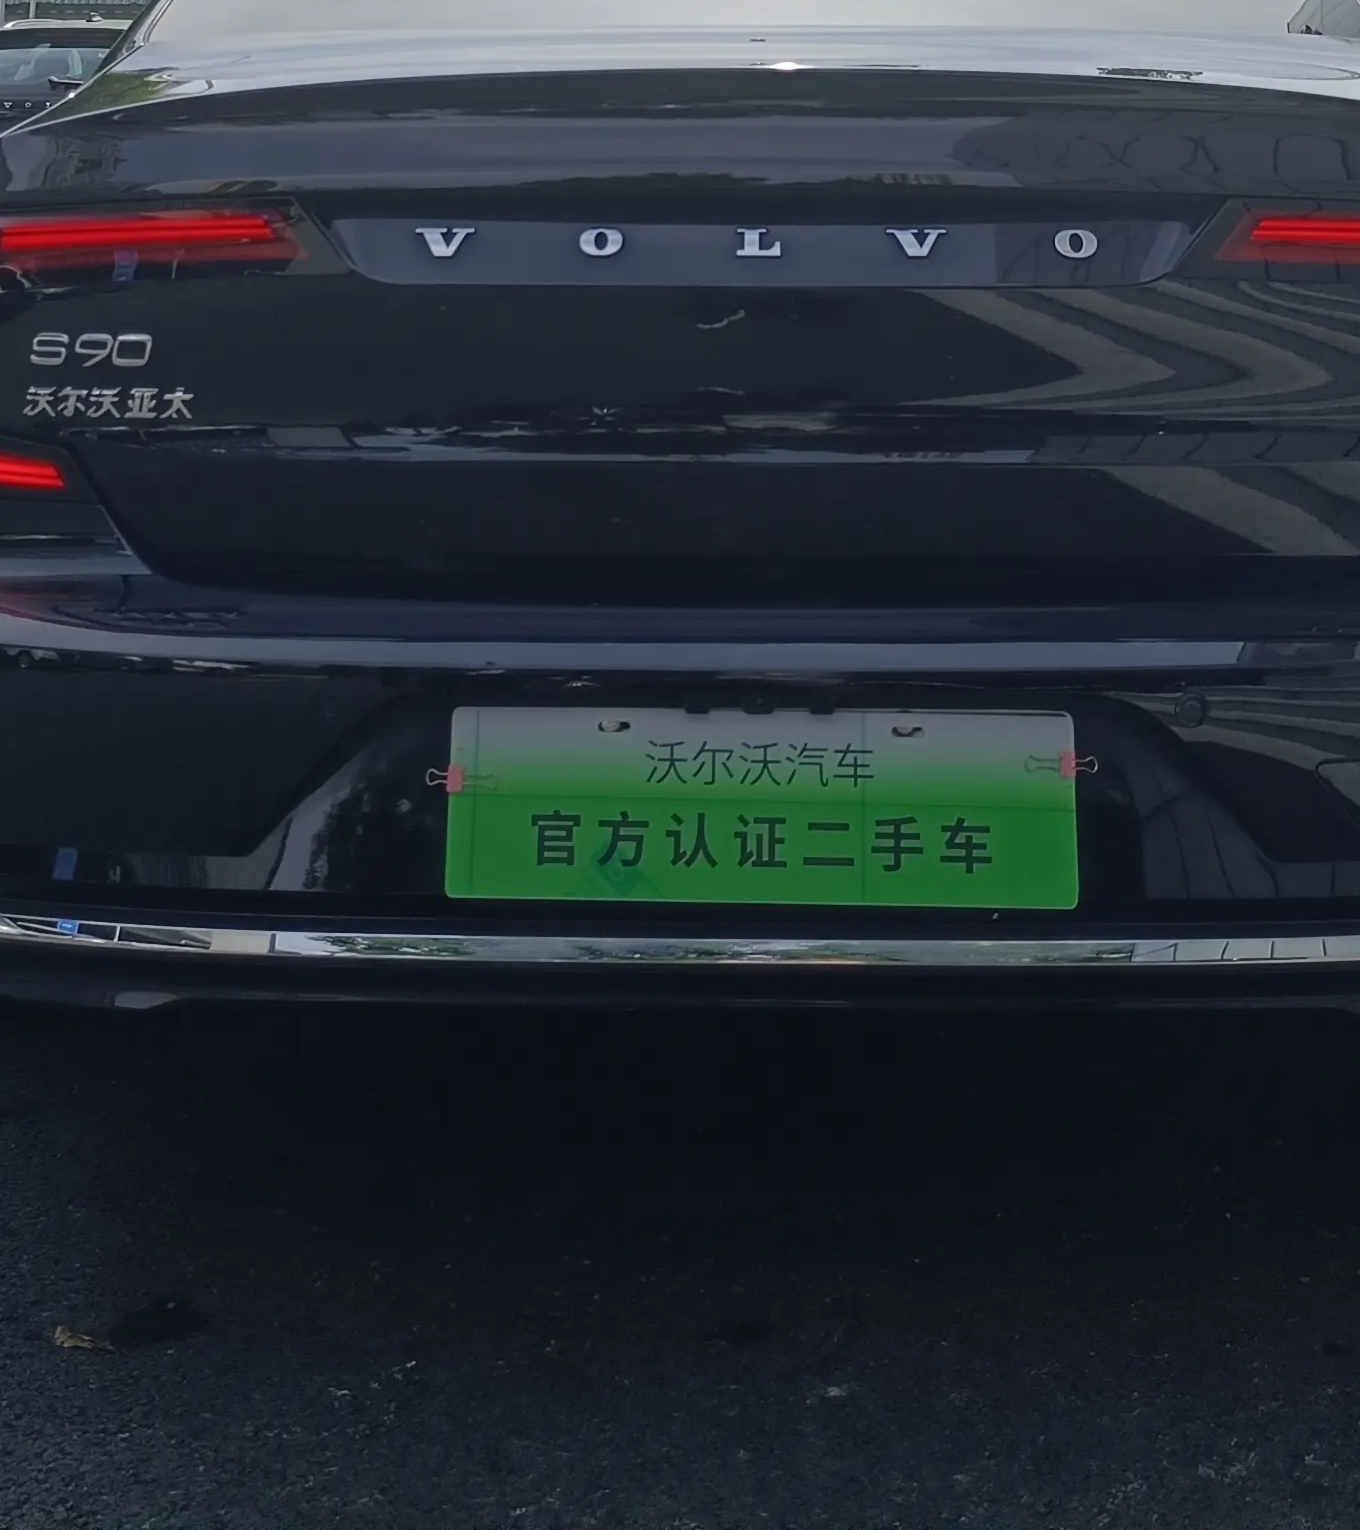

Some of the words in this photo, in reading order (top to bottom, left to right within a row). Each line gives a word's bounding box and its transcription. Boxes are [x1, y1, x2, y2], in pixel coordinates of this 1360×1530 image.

[414, 226, 1099, 259] VOLVO
[29, 331, 153, 368] S90
[22, 385, 195, 420] 沃尔沃亚太
[644, 738, 876, 789] 沃尔沃汽车
[530, 808, 993, 875] 官方认证二手车
